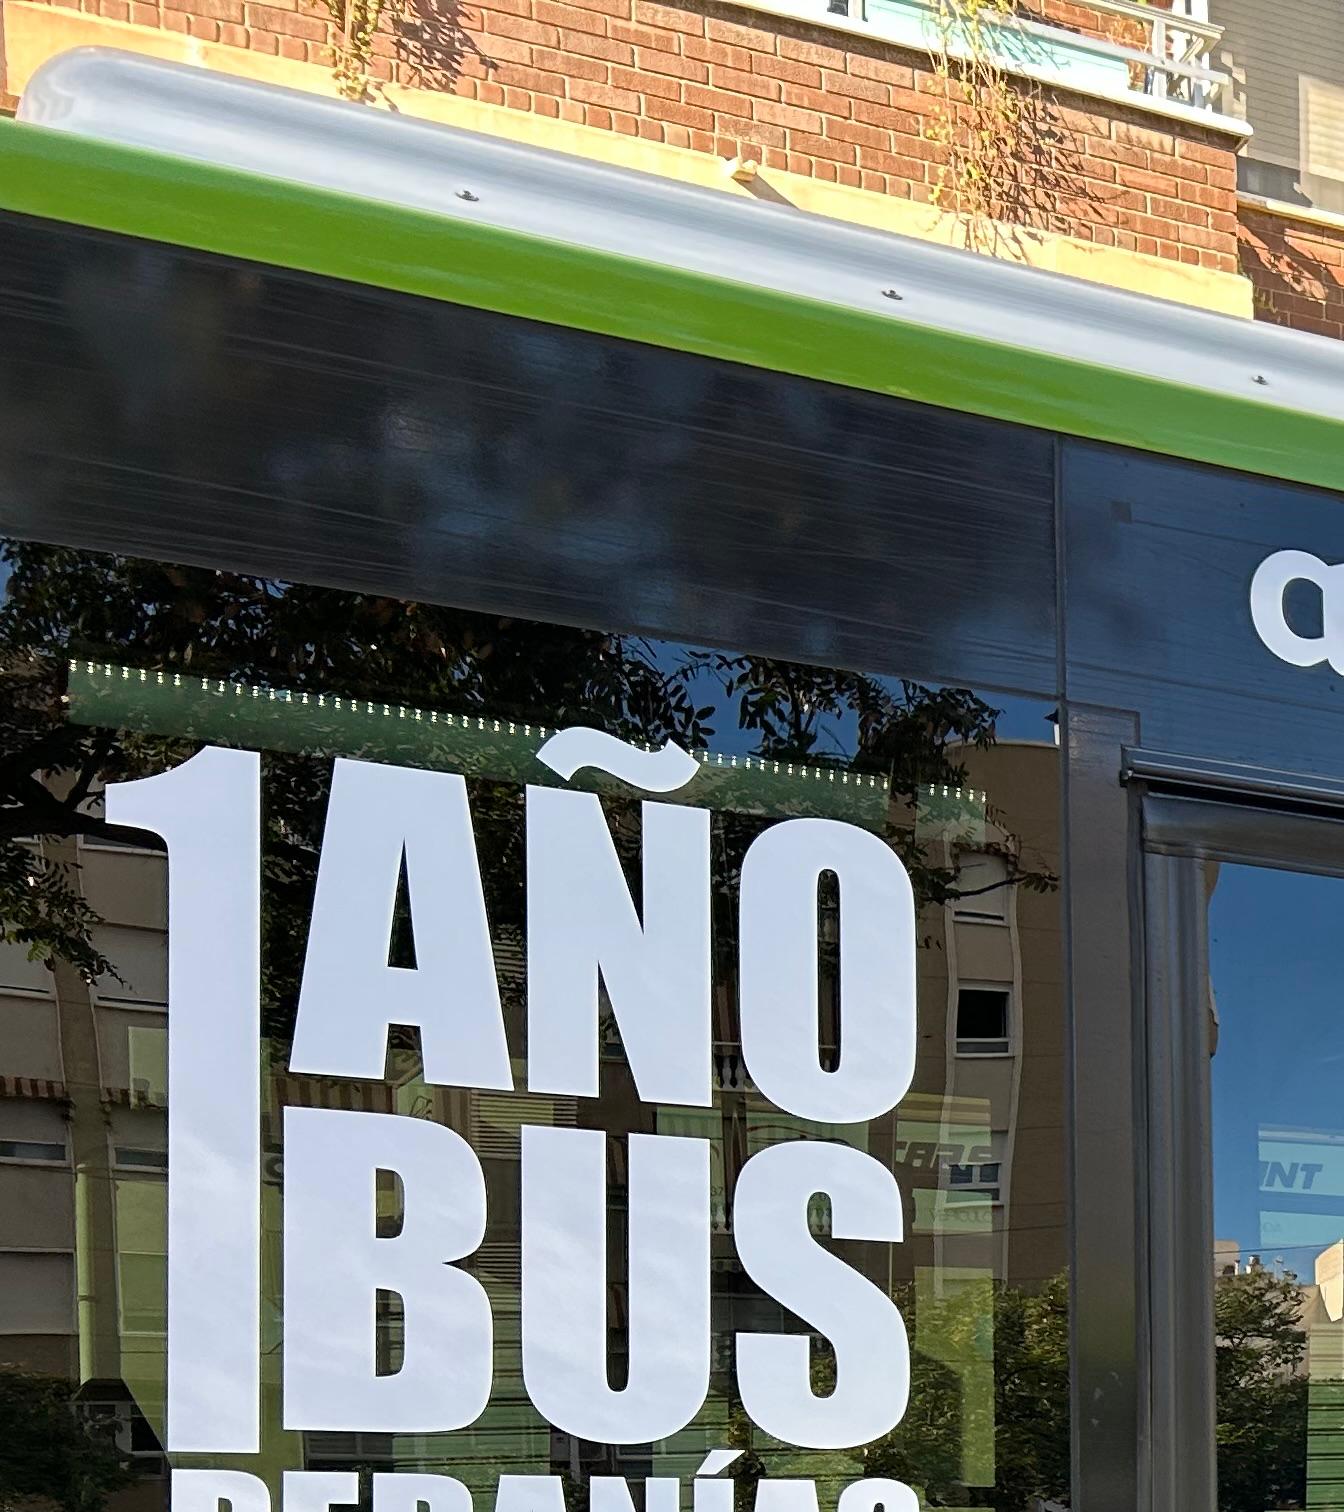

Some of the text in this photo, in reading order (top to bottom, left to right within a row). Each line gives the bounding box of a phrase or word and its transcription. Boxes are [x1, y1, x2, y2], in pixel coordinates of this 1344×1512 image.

[104, 726, 917, 1453] 1 AÑO
[282, 1105, 911, 1451] BUS
